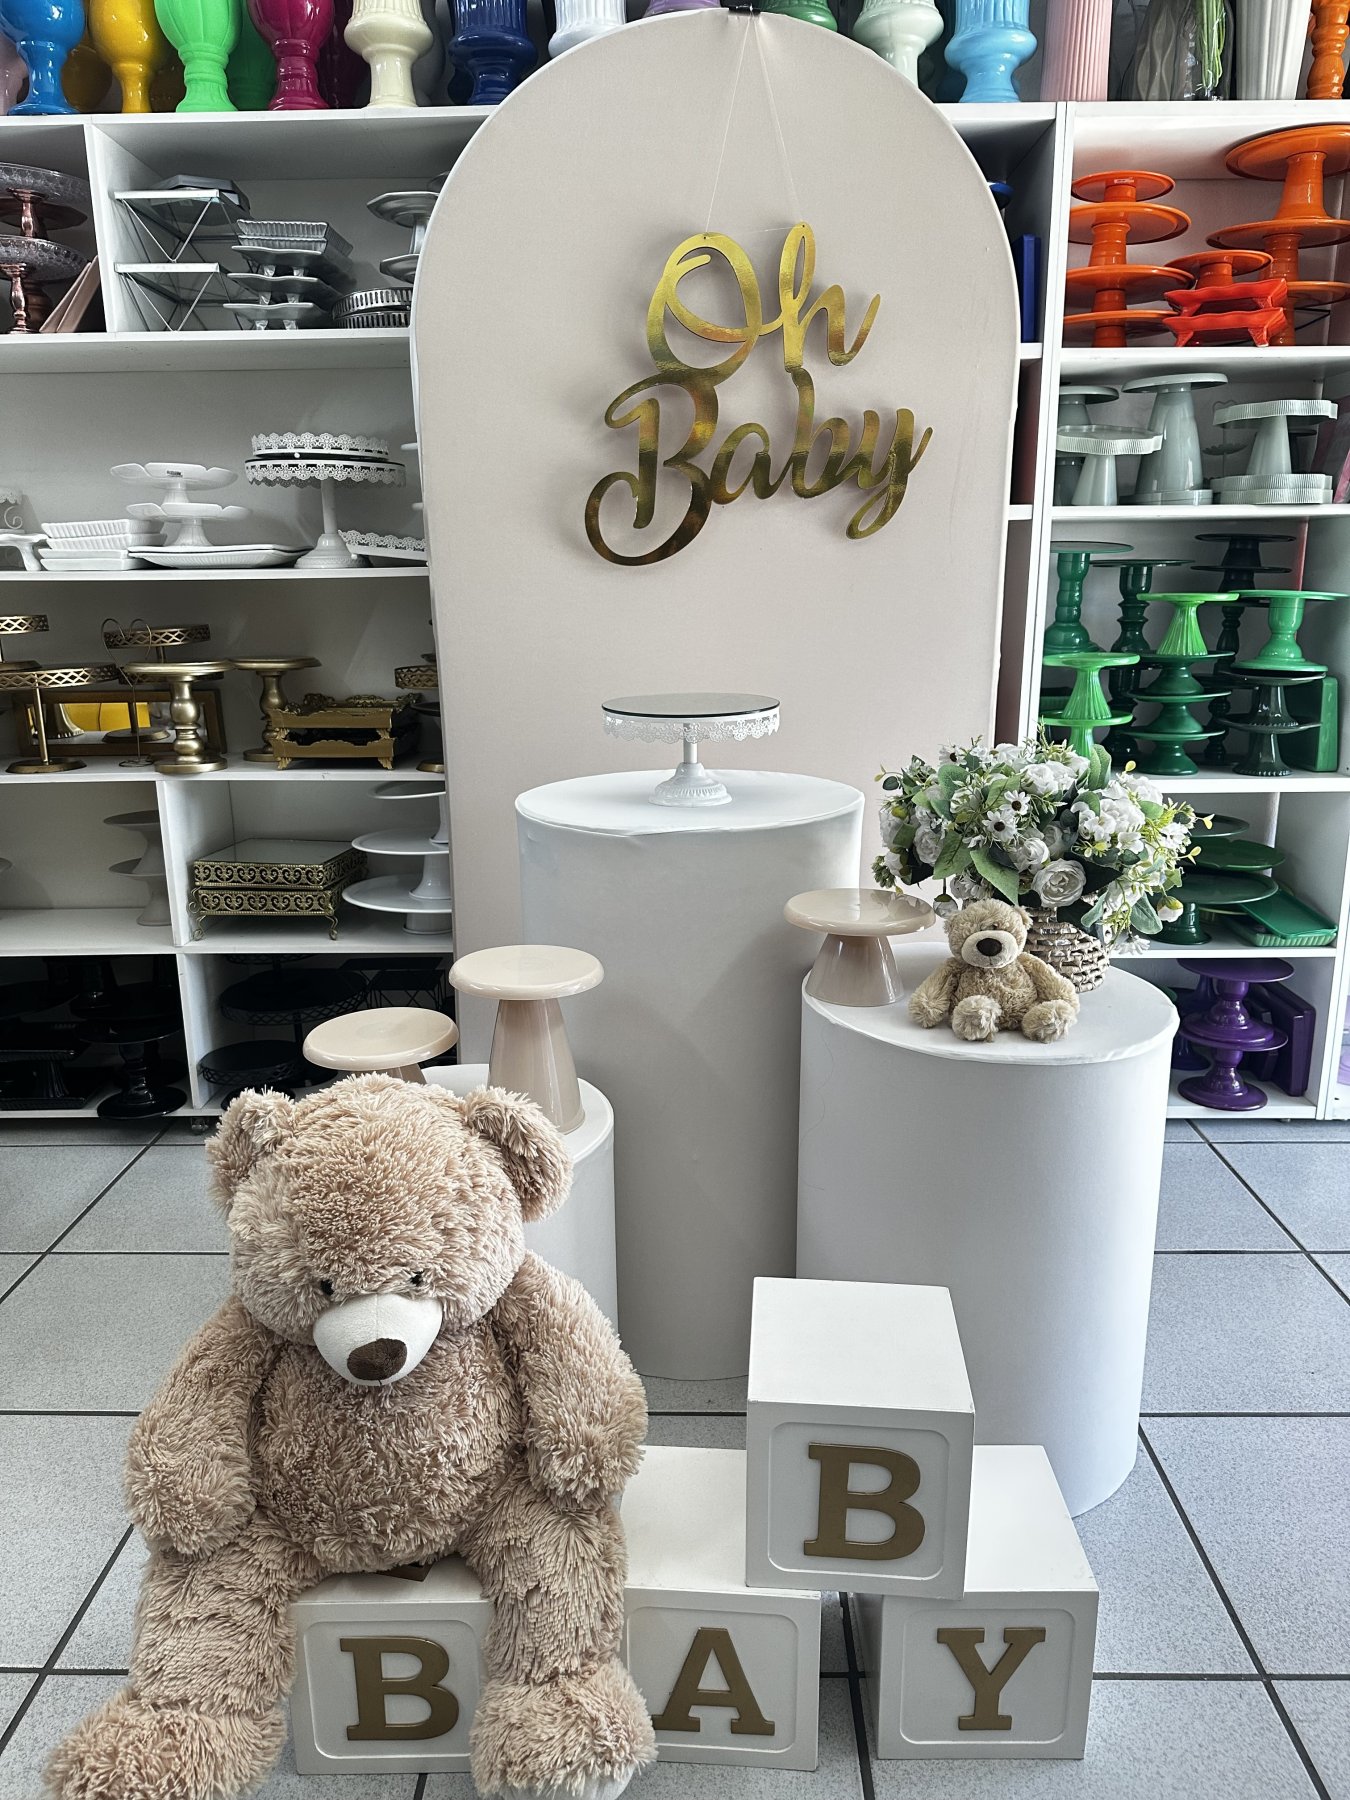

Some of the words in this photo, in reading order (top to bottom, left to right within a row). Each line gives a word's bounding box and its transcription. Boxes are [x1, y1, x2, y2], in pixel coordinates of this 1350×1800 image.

[647, 222, 880, 373] Oh
[585, 367, 933, 566] Baby
[804, 1442, 925, 1560] B
[339, 1636, 459, 1741] B
[652, 1627, 775, 1736] A
[937, 1627, 1046, 1731] Y
